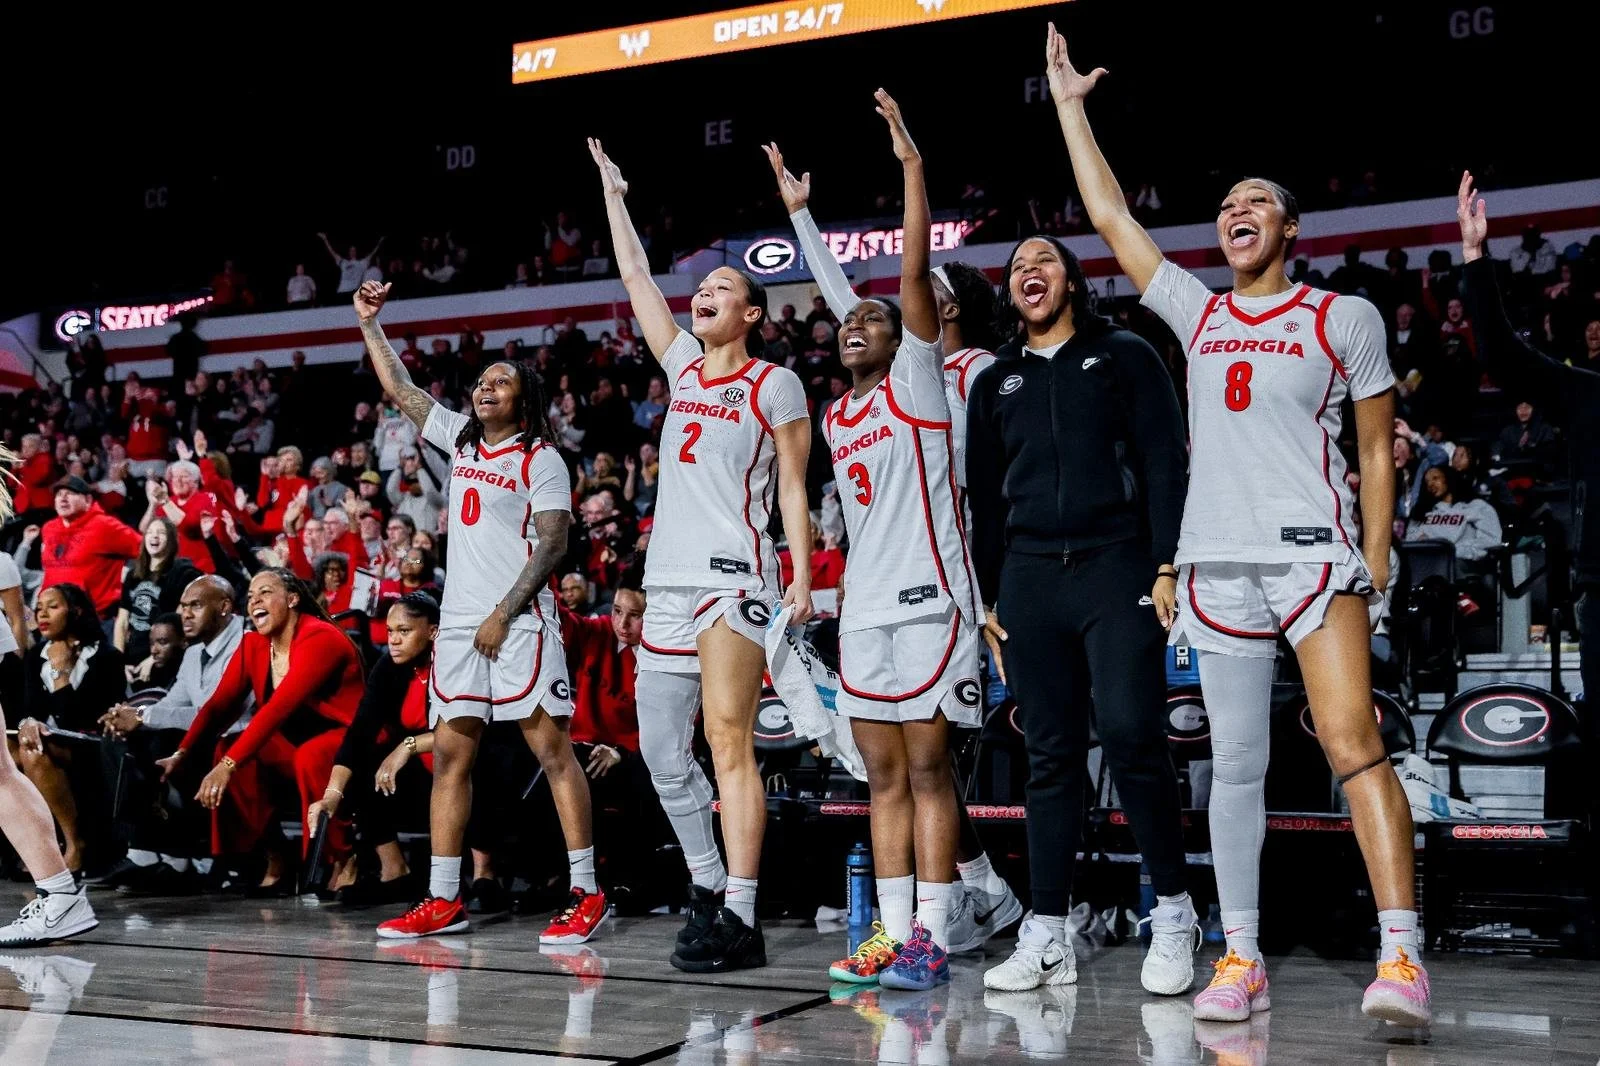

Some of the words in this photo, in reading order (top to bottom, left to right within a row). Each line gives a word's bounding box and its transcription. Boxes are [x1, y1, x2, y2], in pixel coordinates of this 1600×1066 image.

[714, 15, 778, 42] OPEN
[784, 4, 844, 32] 24/7
[1449, 5, 1496, 39] GG
[704, 119, 733, 147] EE
[446, 144, 477, 171] DD
[144, 185, 169, 209] CC
[1200, 339, 1304, 358] GEORGIA
[1224, 361, 1253, 412] 8
[670, 400, 740, 424] GEORGIA
[679, 422, 703, 464] 2
[831, 425, 893, 465] EORGIA
[453, 465, 517, 493] GEORGIA
[847, 462, 872, 506] 3
[461, 487, 480, 526] 0
[1453, 825, 1547, 839] GEORGIA
